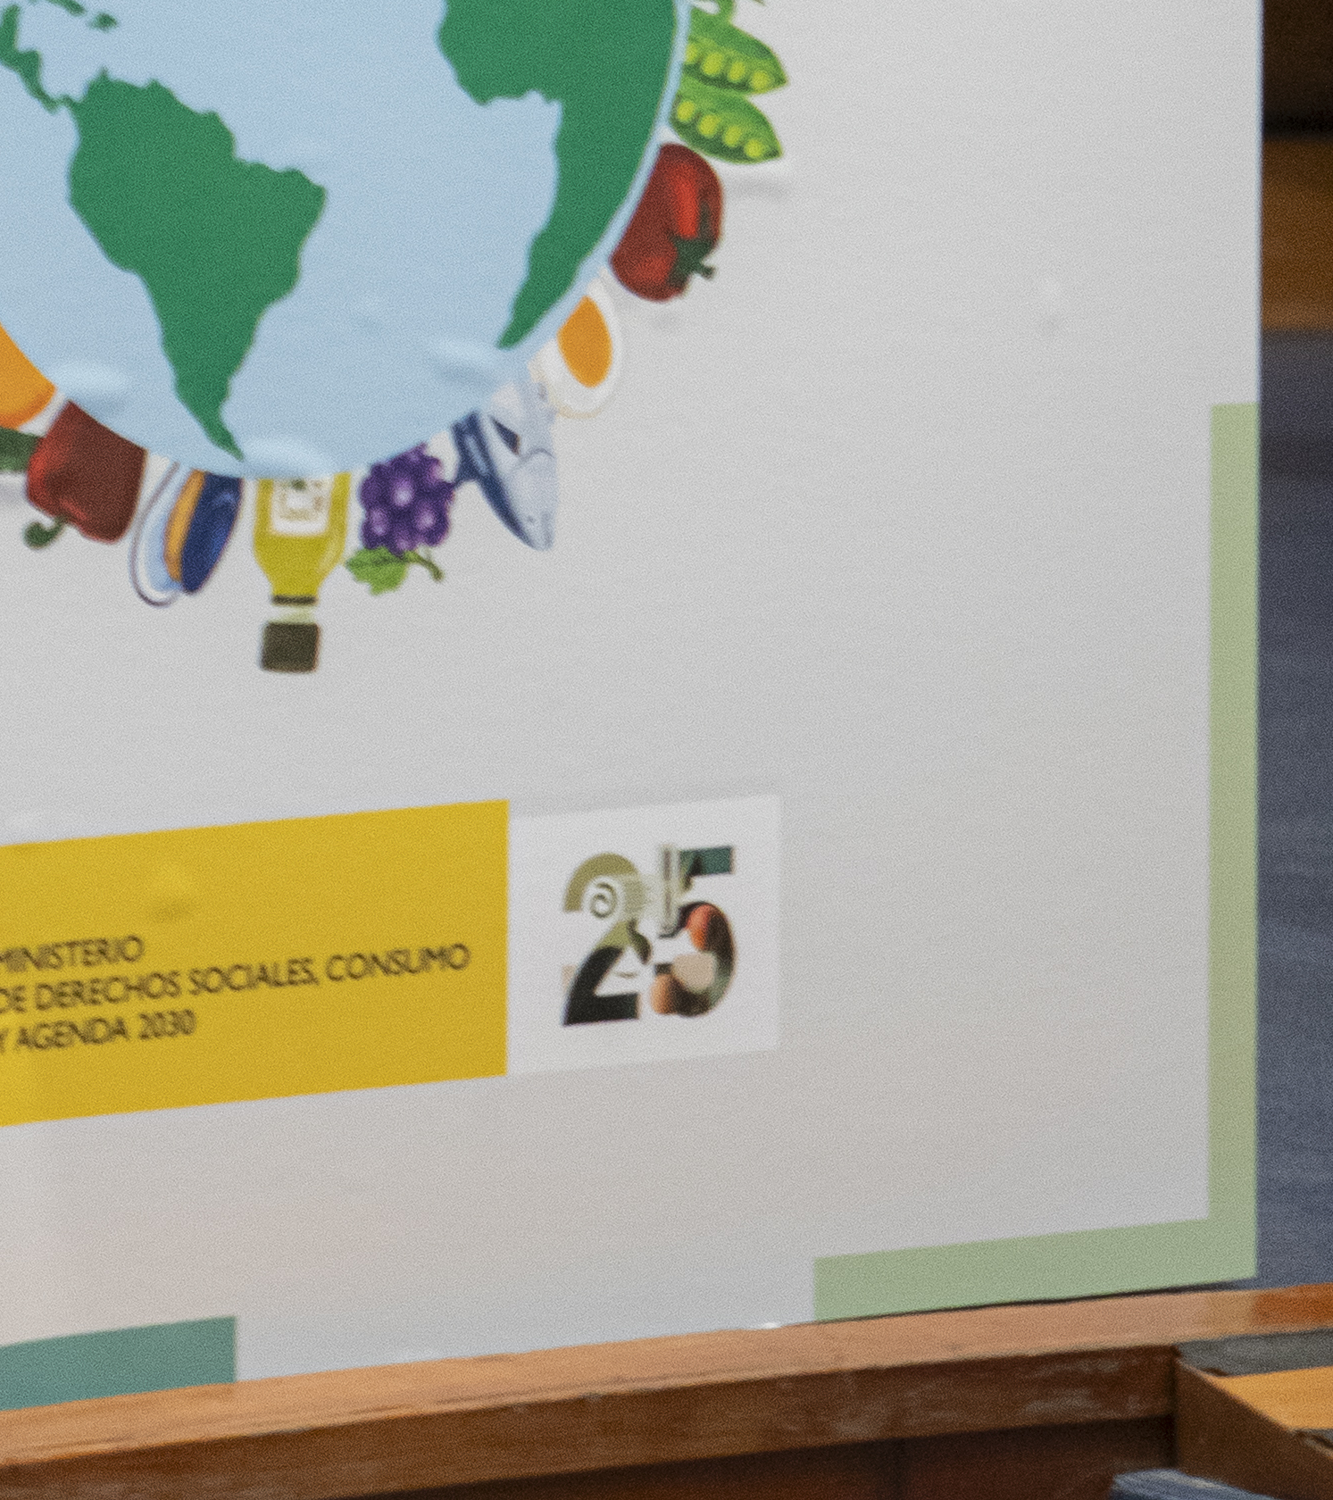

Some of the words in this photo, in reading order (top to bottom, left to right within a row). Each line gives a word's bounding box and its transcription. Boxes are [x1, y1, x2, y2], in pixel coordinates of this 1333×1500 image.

[34, 970, 183, 1013] DERECHOS
[324, 941, 472, 984] CONSUMO
[16, 1017, 131, 1053] AGENDA
[138, 1007, 197, 1042] 2030
